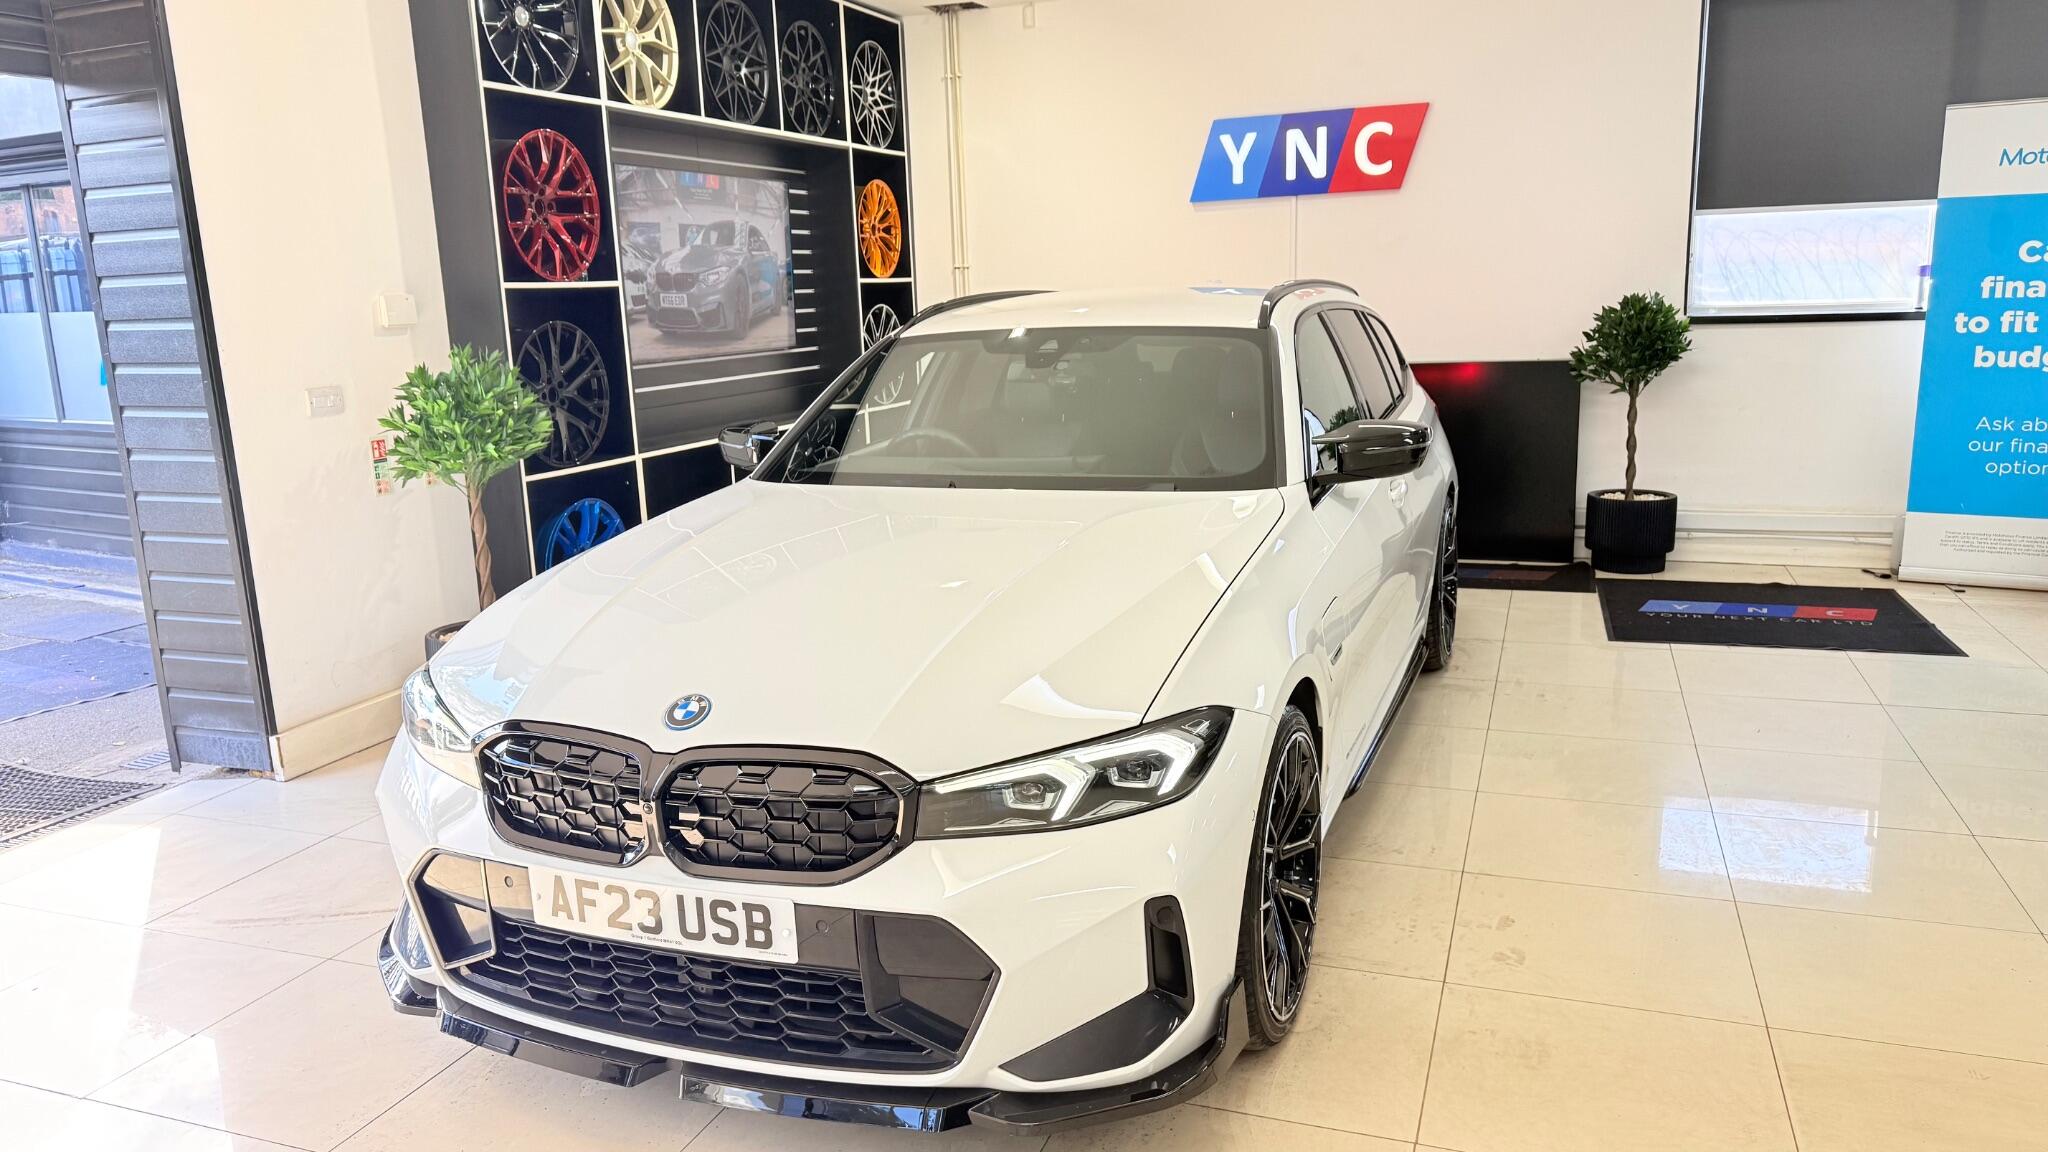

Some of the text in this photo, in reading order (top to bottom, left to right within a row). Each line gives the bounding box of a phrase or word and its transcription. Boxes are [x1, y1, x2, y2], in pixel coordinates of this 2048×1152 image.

[1219, 121, 1393, 185] YNC
[1999, 147, 2048, 167] Mot
[2018, 240, 2048, 263] C
[1954, 310, 2039, 334] to fit
[1975, 416, 2014, 431] Ask
[1968, 438, 2048, 454] our fina
[551, 874, 773, 950] AF23 USB
